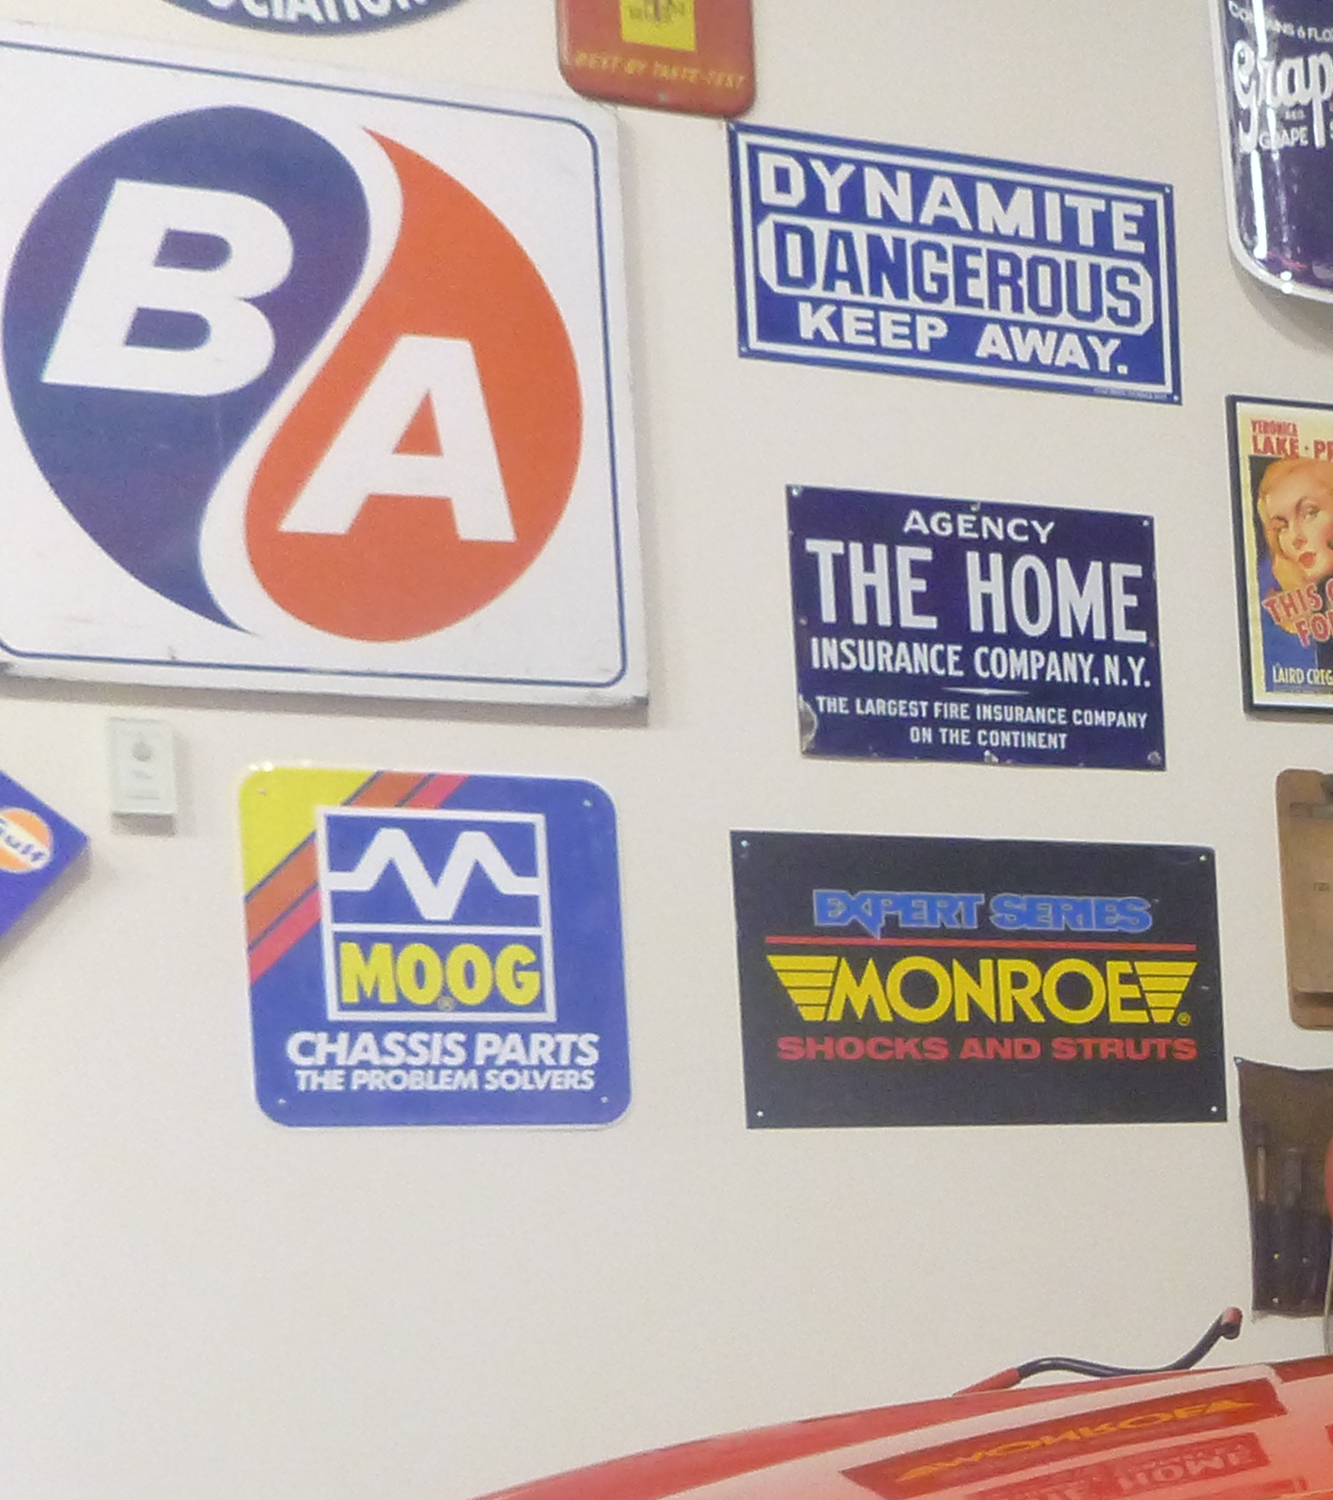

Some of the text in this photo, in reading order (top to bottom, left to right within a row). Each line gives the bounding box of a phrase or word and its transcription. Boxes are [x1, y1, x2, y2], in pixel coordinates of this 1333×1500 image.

[758, 153, 1146, 253] DYNAMITE
[774, 220, 1141, 328] DANGEROUS
[42, 178, 517, 543] B A
[799, 302, 1129, 375] KEEP AWAY.
[1252, 435, 1300, 457] LAKE
[903, 510, 1055, 543] AGENCY
[805, 538, 1147, 643] THE HOME
[1262, 582, 1323, 624] THIS
[811, 637, 1152, 688] INSURANCE COMPANY, N.Y.
[1273, 665, 1305, 684] LAIRD
[815, 696, 1148, 729] THE LARGEST FIRE INSURANCE COMPANY
[910, 726, 1068, 750] ON THE CONTINENT
[813, 889, 1153, 939] EXPERT SERIES
[339, 942, 541, 1006] MOOG
[827, 956, 1150, 1024] MONROE
[286, 1031, 601, 1067] CHASSIS PARTS
[777, 1036, 1199, 1062] SHOCKS AND STRUTS
[295, 1069, 596, 1093] THE PROBLEM SOLVERS
